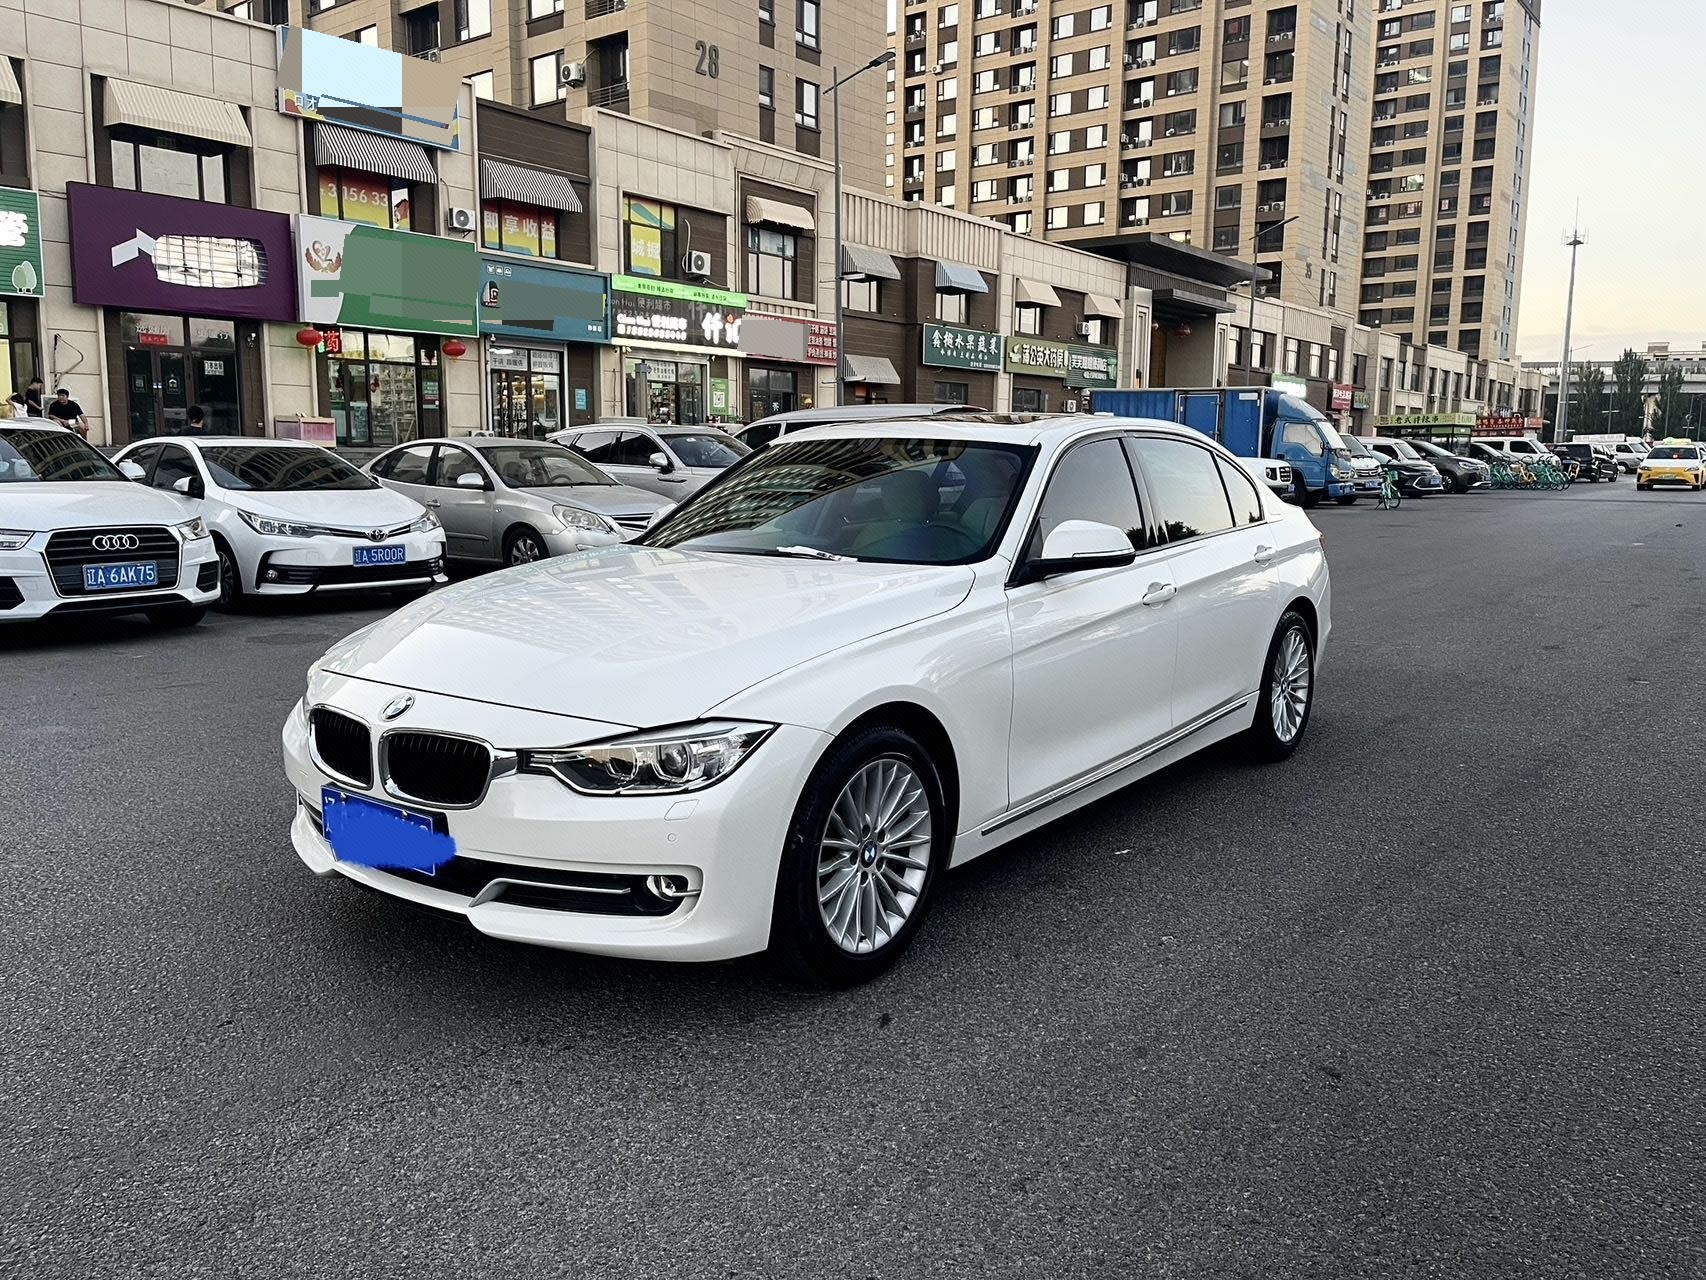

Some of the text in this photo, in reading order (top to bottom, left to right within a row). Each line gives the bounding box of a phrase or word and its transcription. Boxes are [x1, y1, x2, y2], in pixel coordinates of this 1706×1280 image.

[695, 40, 719, 79] 28
[484, 210, 556, 241] 即享收益
[325, 329, 341, 352] 药
[1022, 343, 1064, 369] 蒲公英大药房
